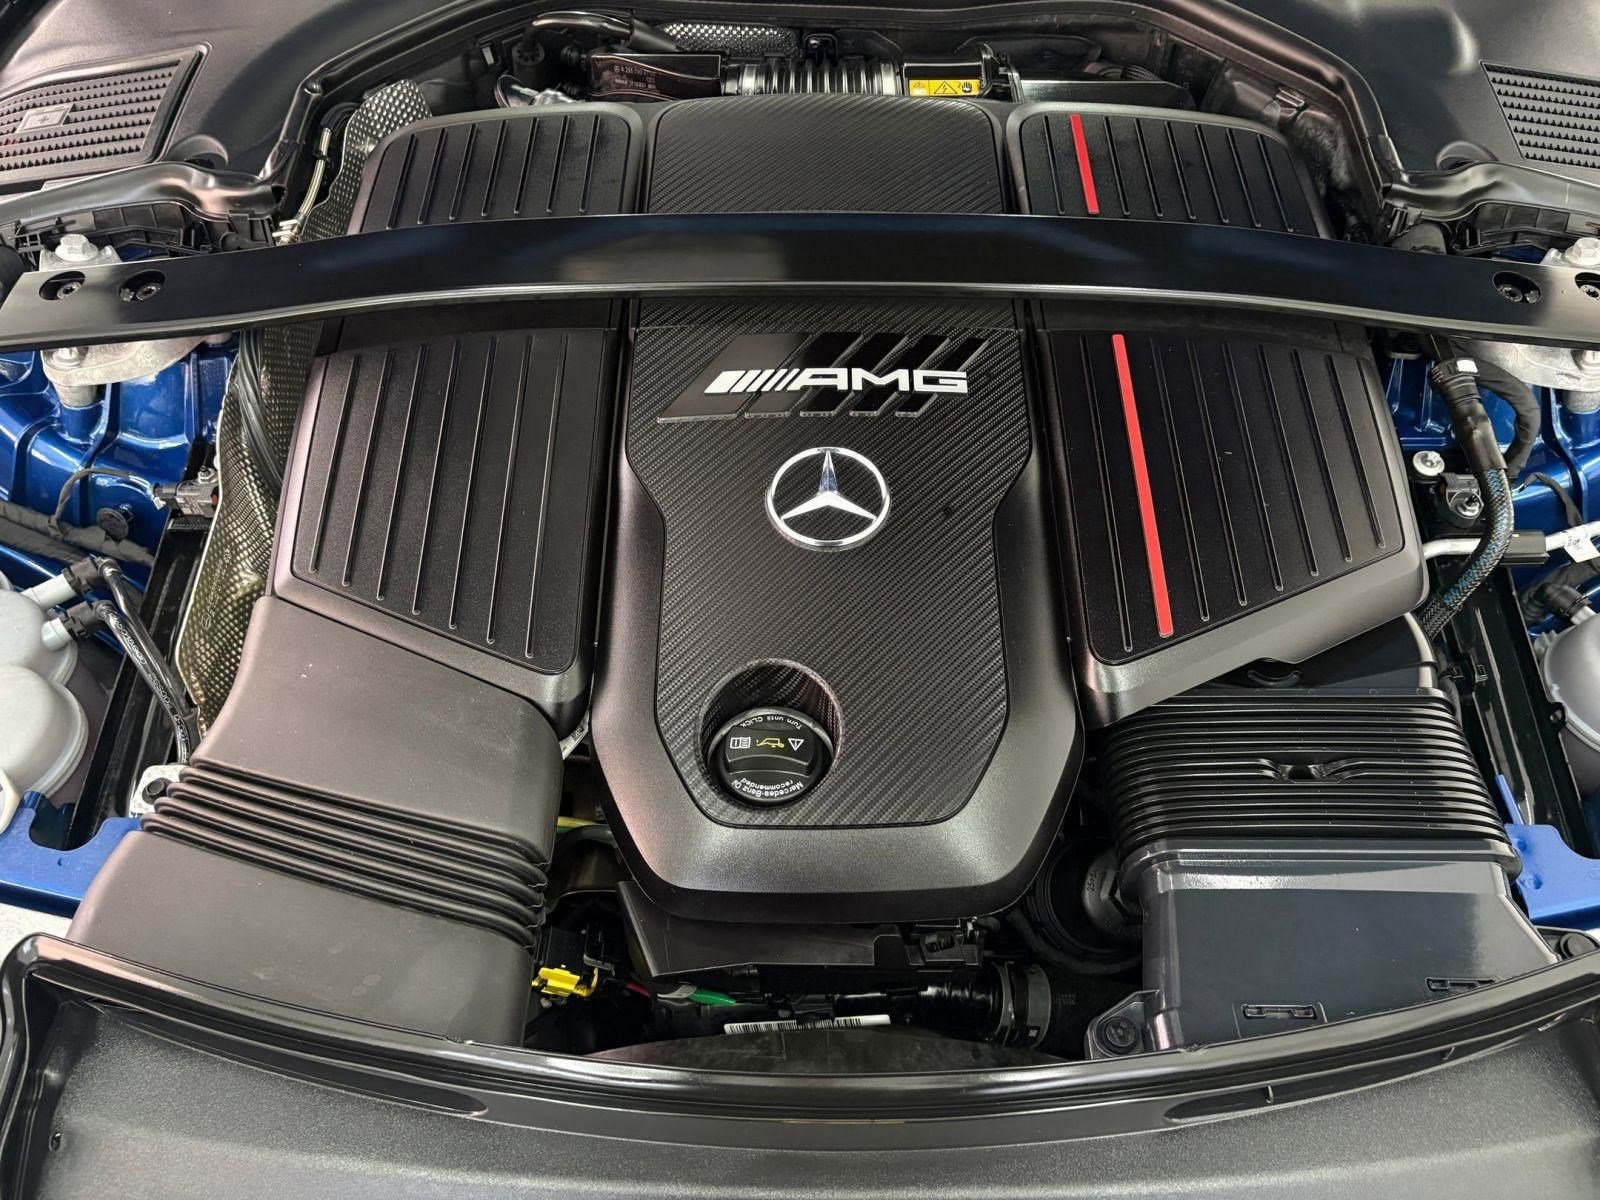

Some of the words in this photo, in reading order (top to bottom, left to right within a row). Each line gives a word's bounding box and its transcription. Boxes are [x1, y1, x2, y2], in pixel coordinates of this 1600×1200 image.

[785, 366, 968, 394] AMG
[740, 717, 764, 727] CLICK
[788, 718, 803, 730] Turn
[740, 778, 793, 790] recommended
[742, 781, 804, 798] Mercedes-Benz
